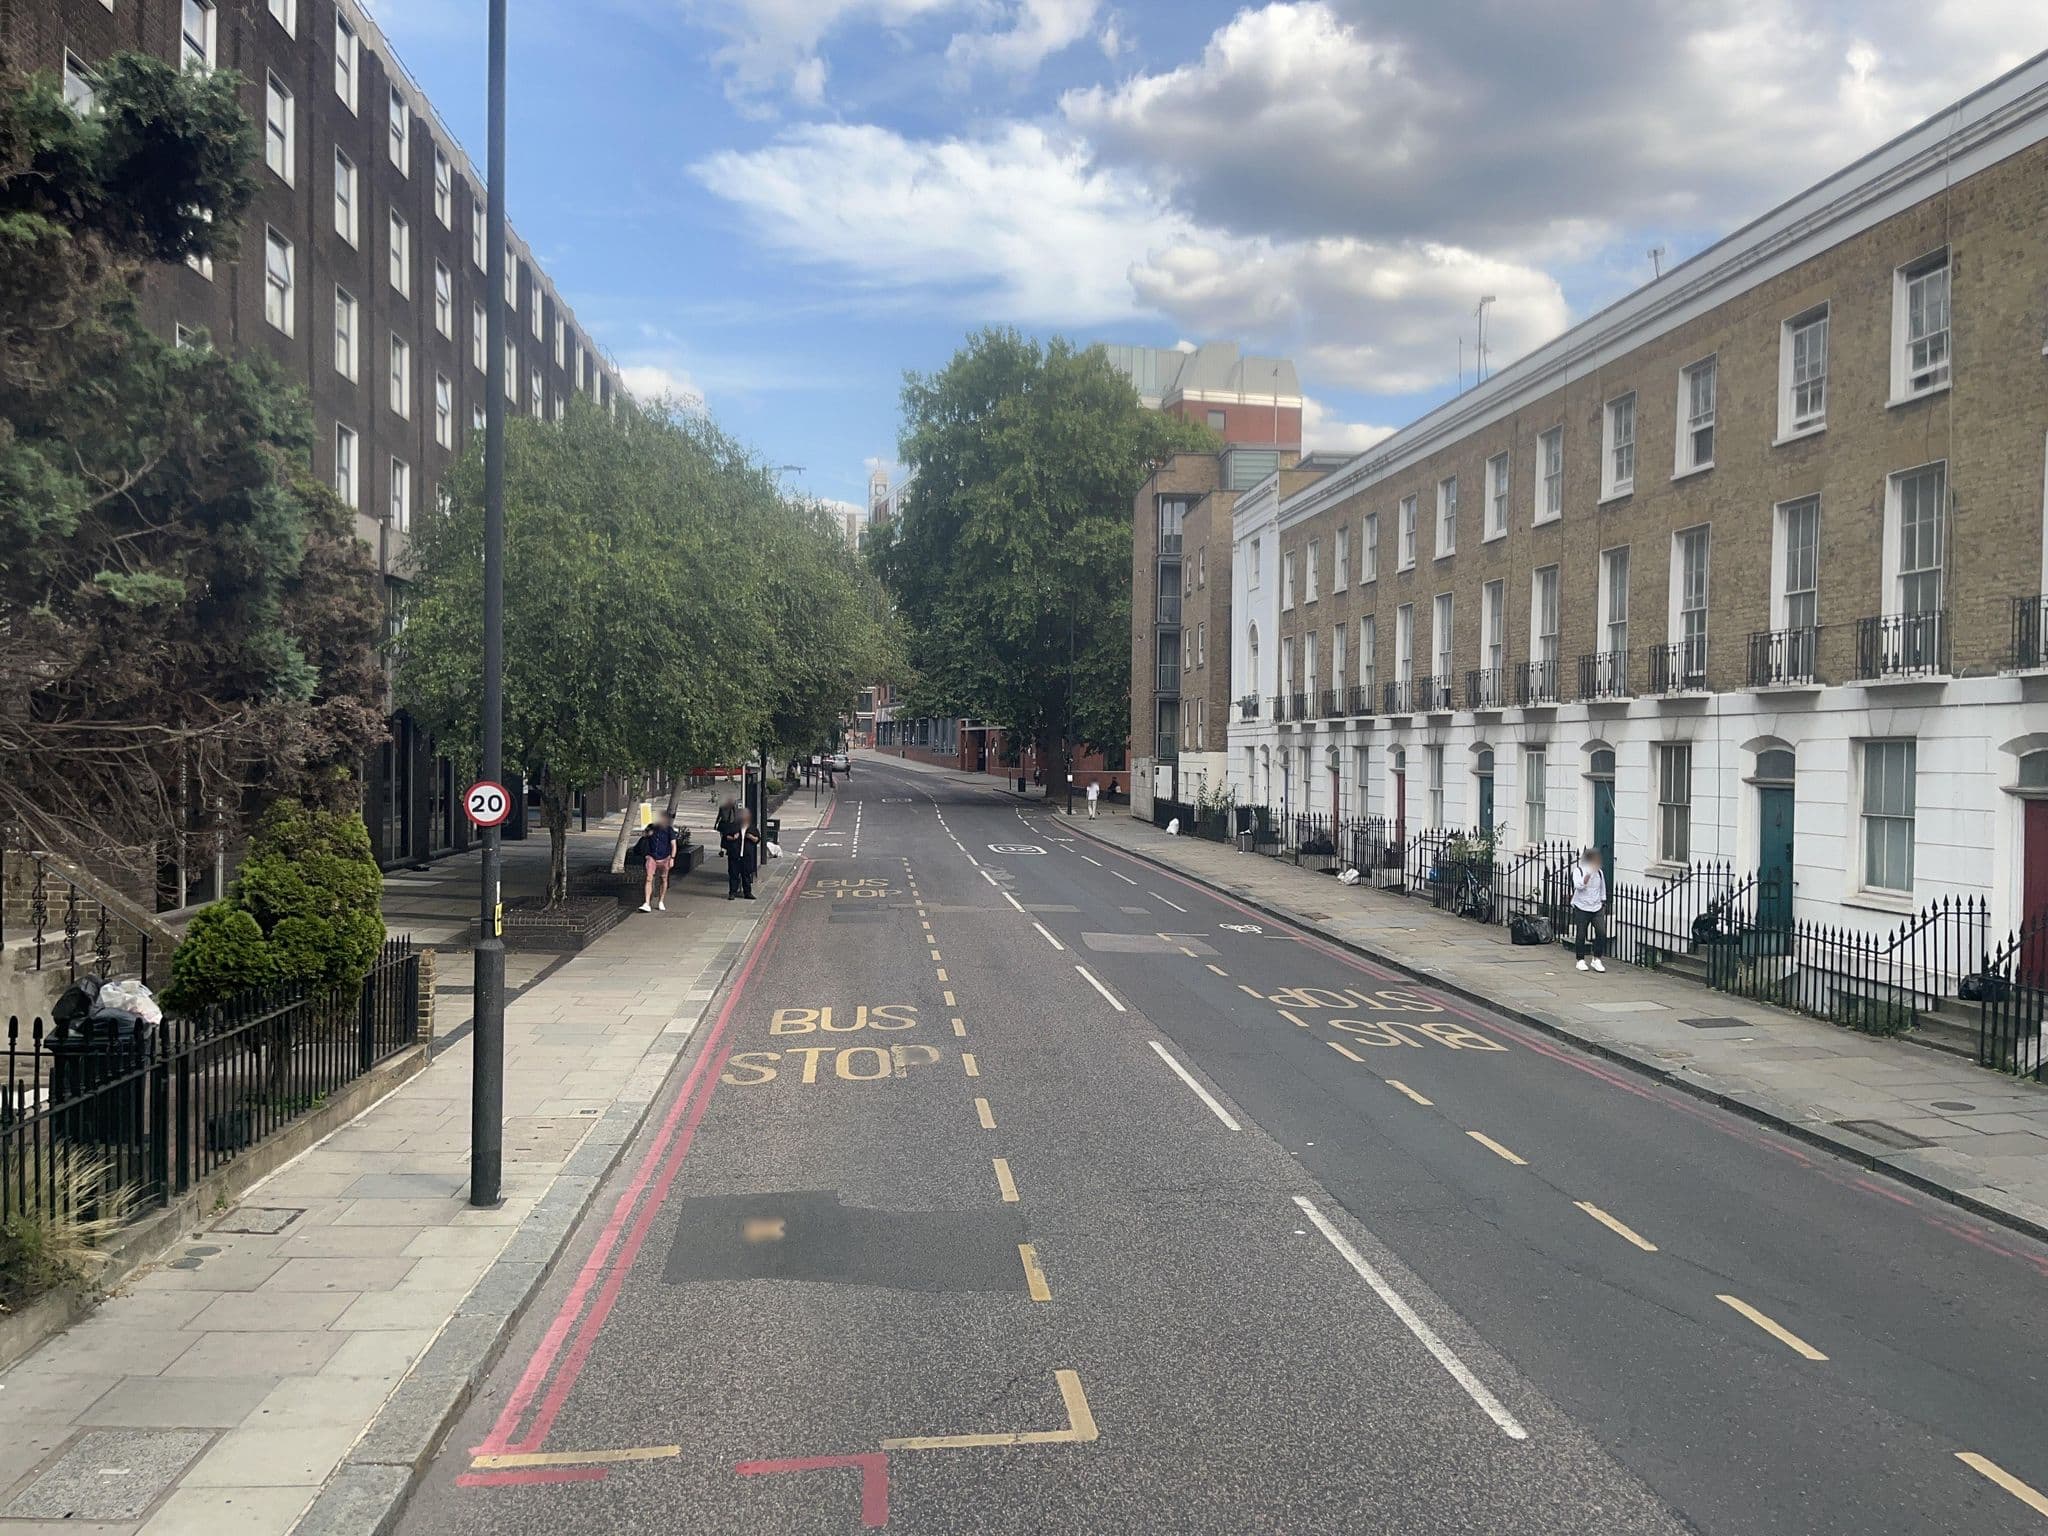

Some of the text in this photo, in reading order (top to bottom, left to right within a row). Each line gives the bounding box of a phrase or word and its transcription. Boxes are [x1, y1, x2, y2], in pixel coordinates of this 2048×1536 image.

[471, 795, 503, 812] 20
[800, 889, 902, 899] STOP
[816, 879, 889, 888] BUS
[1268, 987, 1444, 1012] STOP
[769, 1005, 918, 1035] BUS
[1328, 1019, 1509, 1051] BUS
[721, 1044, 941, 1085] STOP
